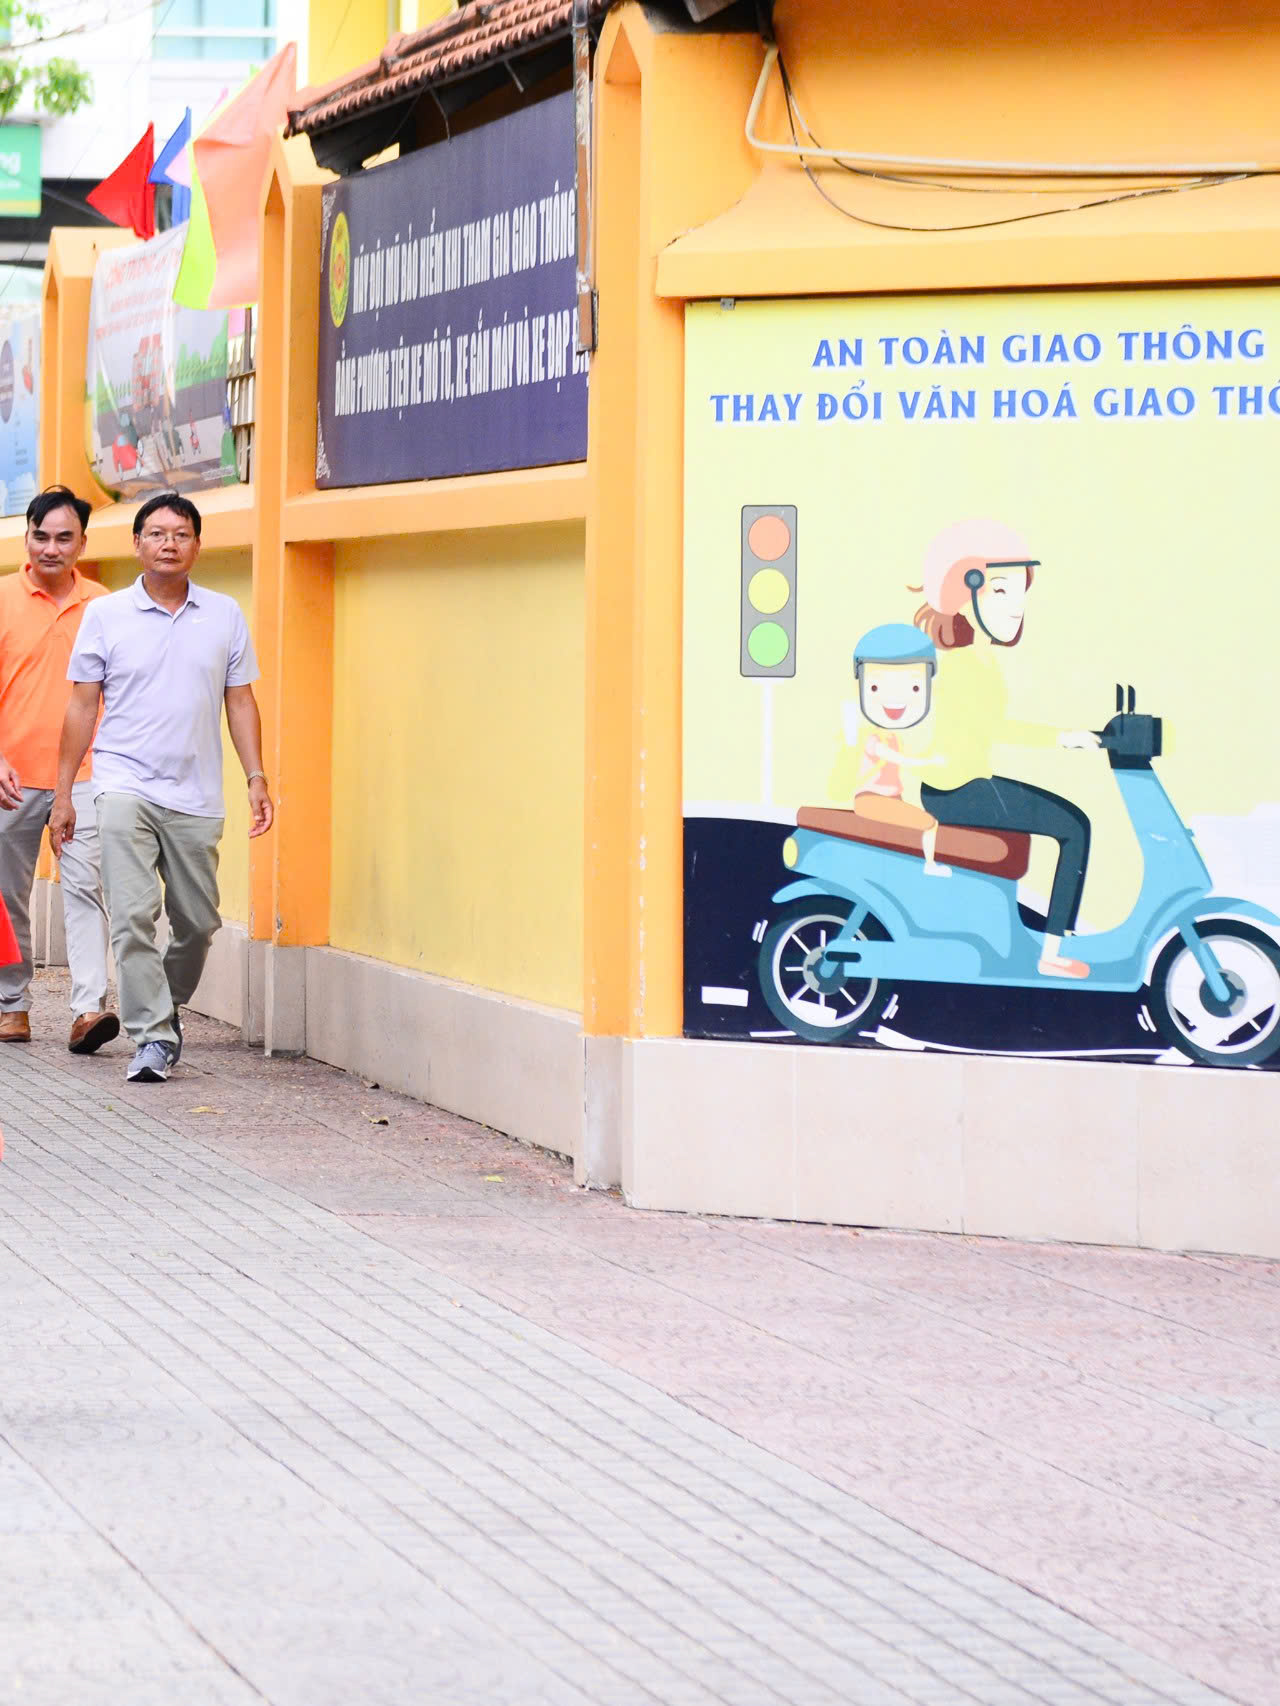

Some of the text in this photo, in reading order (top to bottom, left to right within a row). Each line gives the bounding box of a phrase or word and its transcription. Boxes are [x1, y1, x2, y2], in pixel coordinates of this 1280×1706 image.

[353, 180, 575, 321] HÃY ĐỘI MŨ BẢO HIỂM KHI THAM GIA GIAO THÔNG
[335, 339, 356, 416] BẰNG
[357, 347, 390, 414] PHƯƠNG
[391, 335, 410, 420] TIỆN
[410, 343, 422, 405] XE
[423, 328, 438, 403] MÔ
[456, 334, 468, 398] XE
[470, 308, 490, 396] GẮN
[491, 311, 514, 391] MÁY
[516, 306, 529, 386] VÀ
[531, 315, 545, 383] XE
[547, 309, 570, 393] ĐẠP
[812, 324, 1264, 367] AN TOÀN GIAO THÔNG
[709, 393, 803, 421] THAY
[816, 379, 882, 420] ĐỔI
[898, 385, 976, 418] VĂN
[993, 382, 1077, 418] HOÁ
[1094, 387, 1195, 417] GIAO
